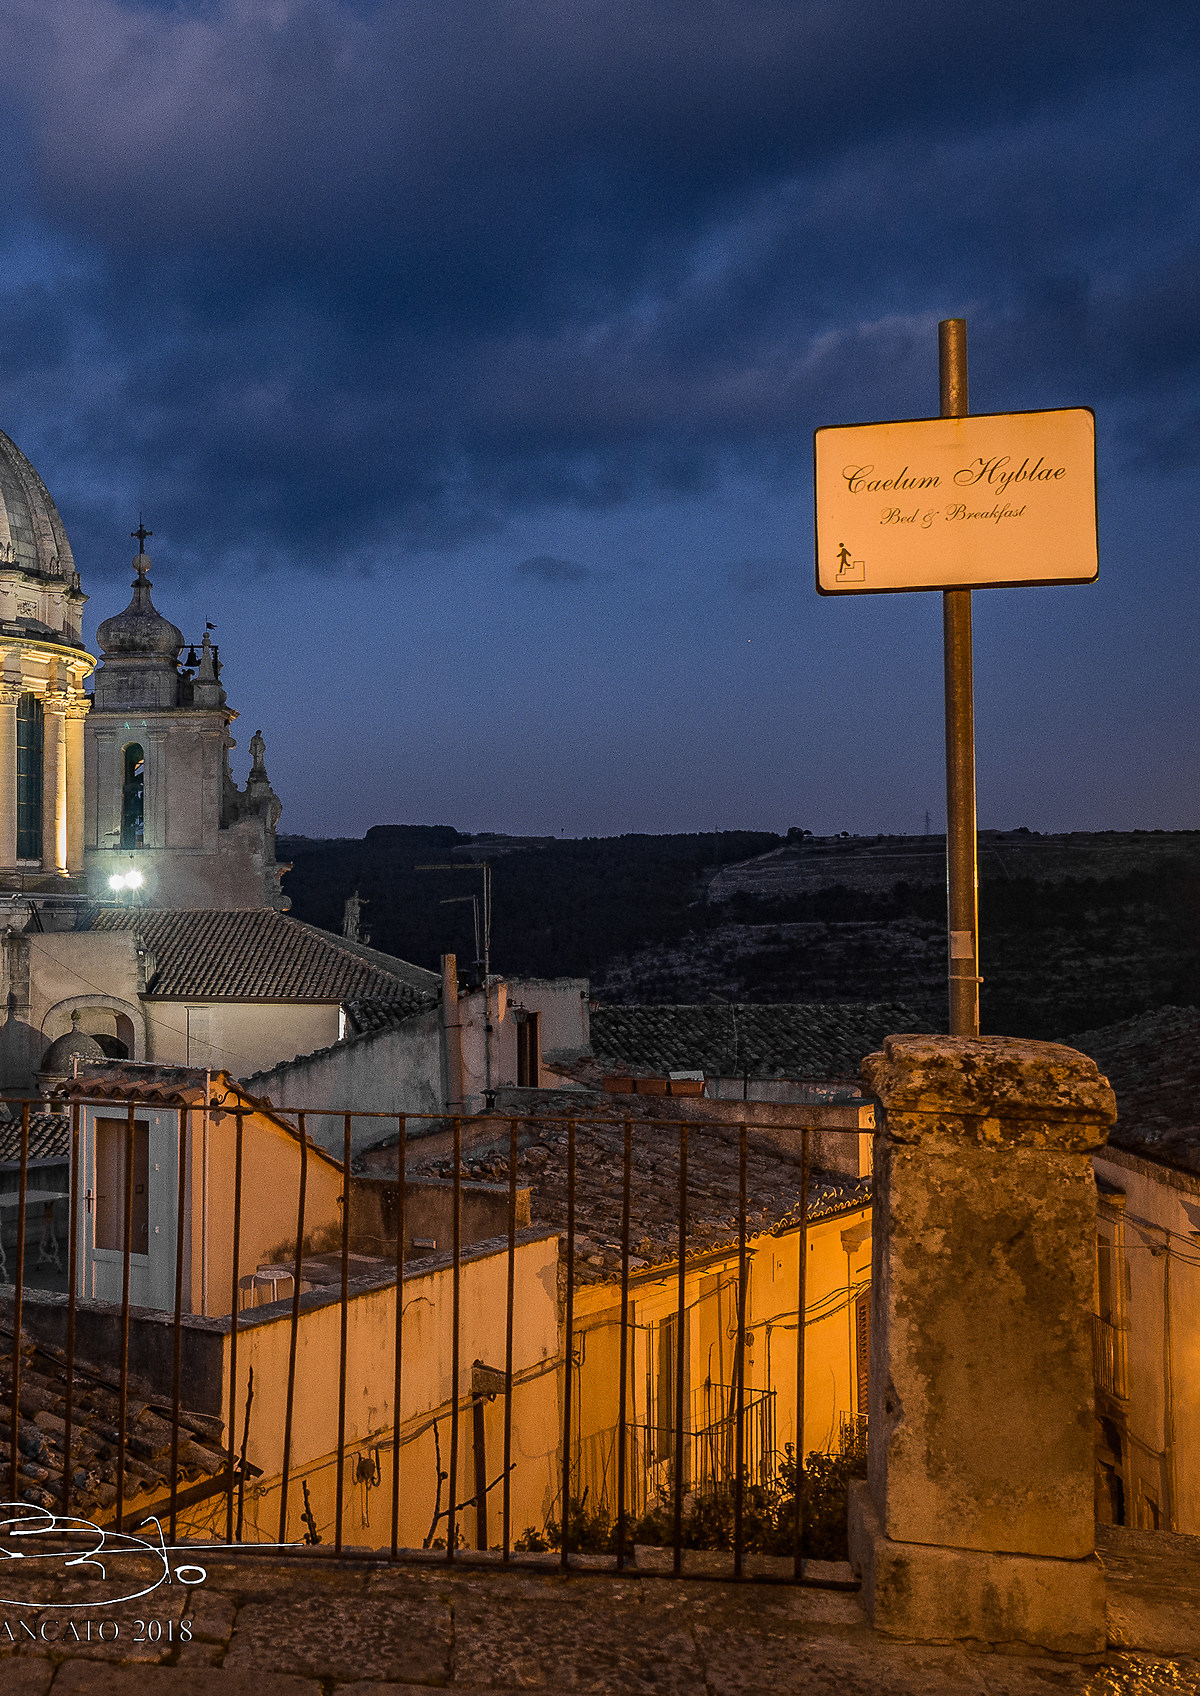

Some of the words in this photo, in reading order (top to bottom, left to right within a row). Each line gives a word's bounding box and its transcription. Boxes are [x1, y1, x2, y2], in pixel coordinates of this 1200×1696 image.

[842, 464, 942, 493] Caelum
[952, 455, 1066, 495] Hyblae
[879, 506, 919, 525] Bed
[921, 509, 939, 529] &
[945, 502, 1027, 525] Breakfast
